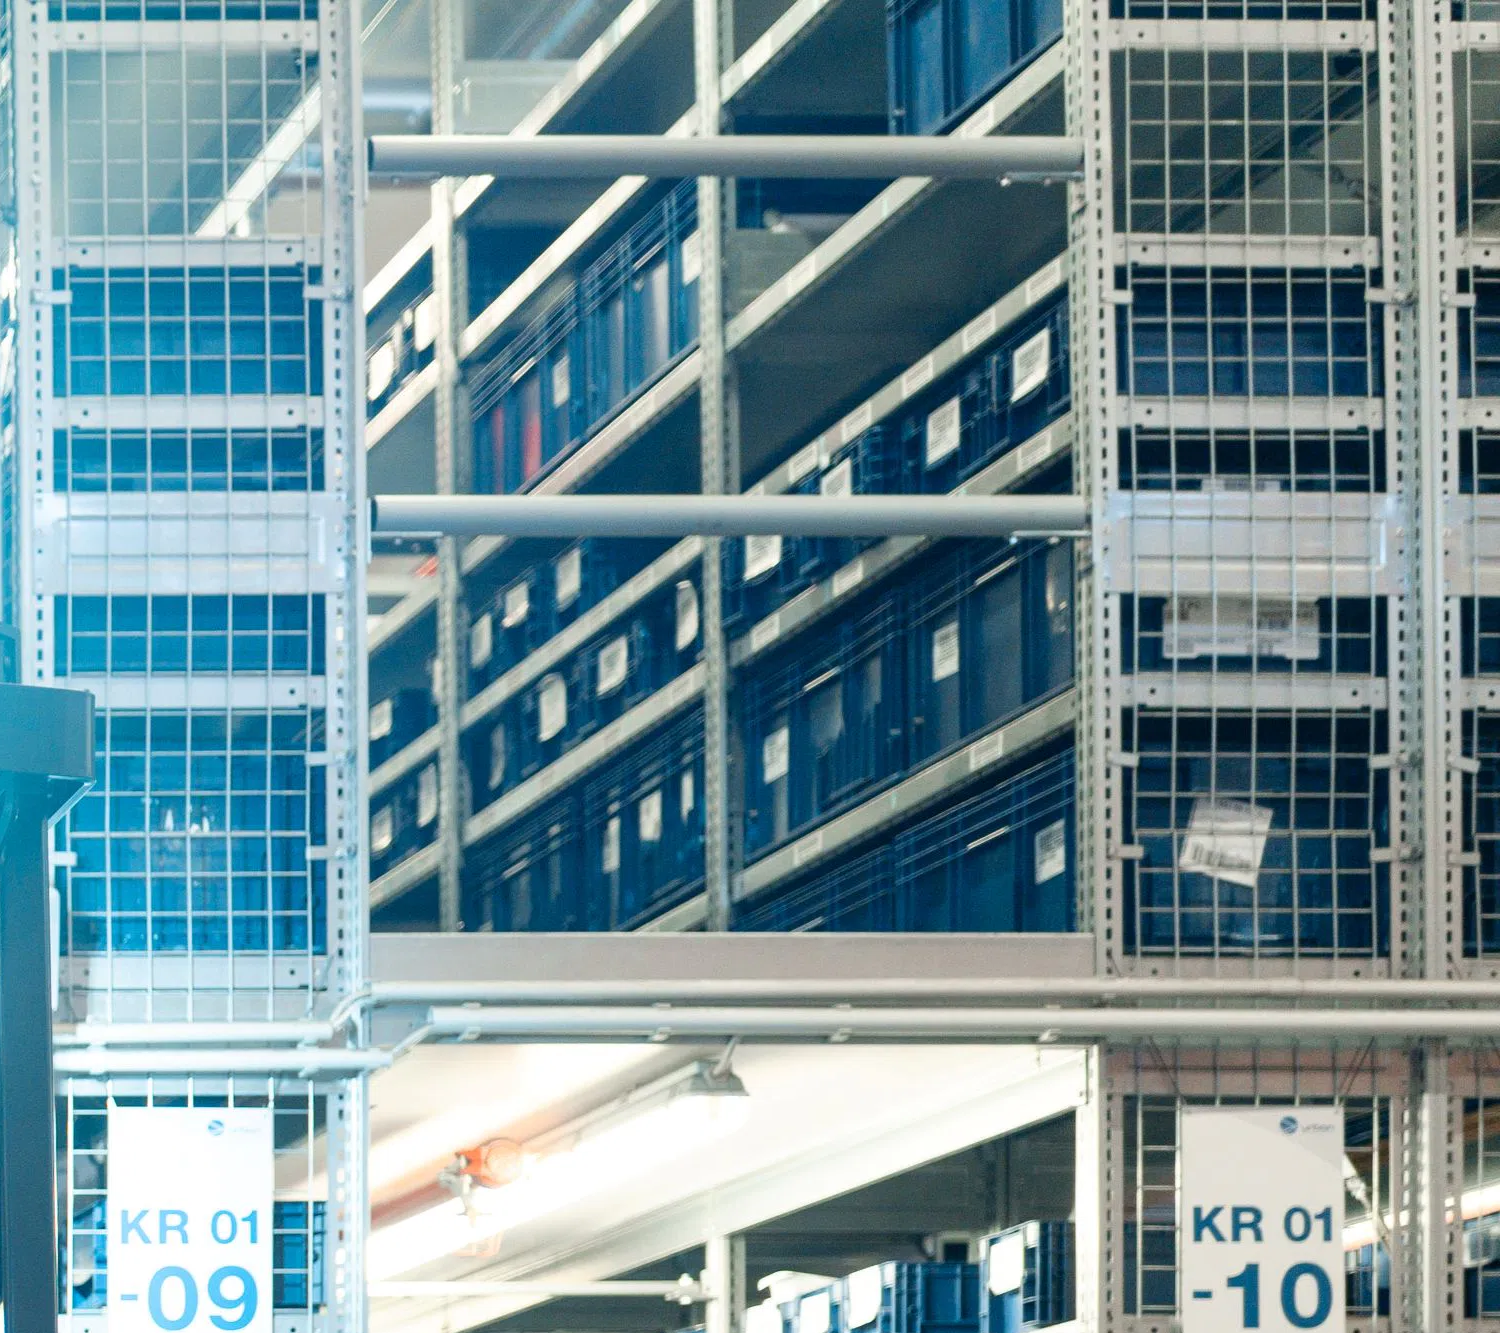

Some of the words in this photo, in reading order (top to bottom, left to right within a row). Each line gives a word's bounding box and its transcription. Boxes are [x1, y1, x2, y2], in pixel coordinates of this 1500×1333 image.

[122, 1210, 190, 1246] KR
[210, 1210, 260, 1246] 01
[1194, 1208, 1263, 1242] KR
[1285, 1208, 1333, 1242] 01
[121, 1266, 260, 1333] -09
[1194, 1264, 1333, 1330] -10
